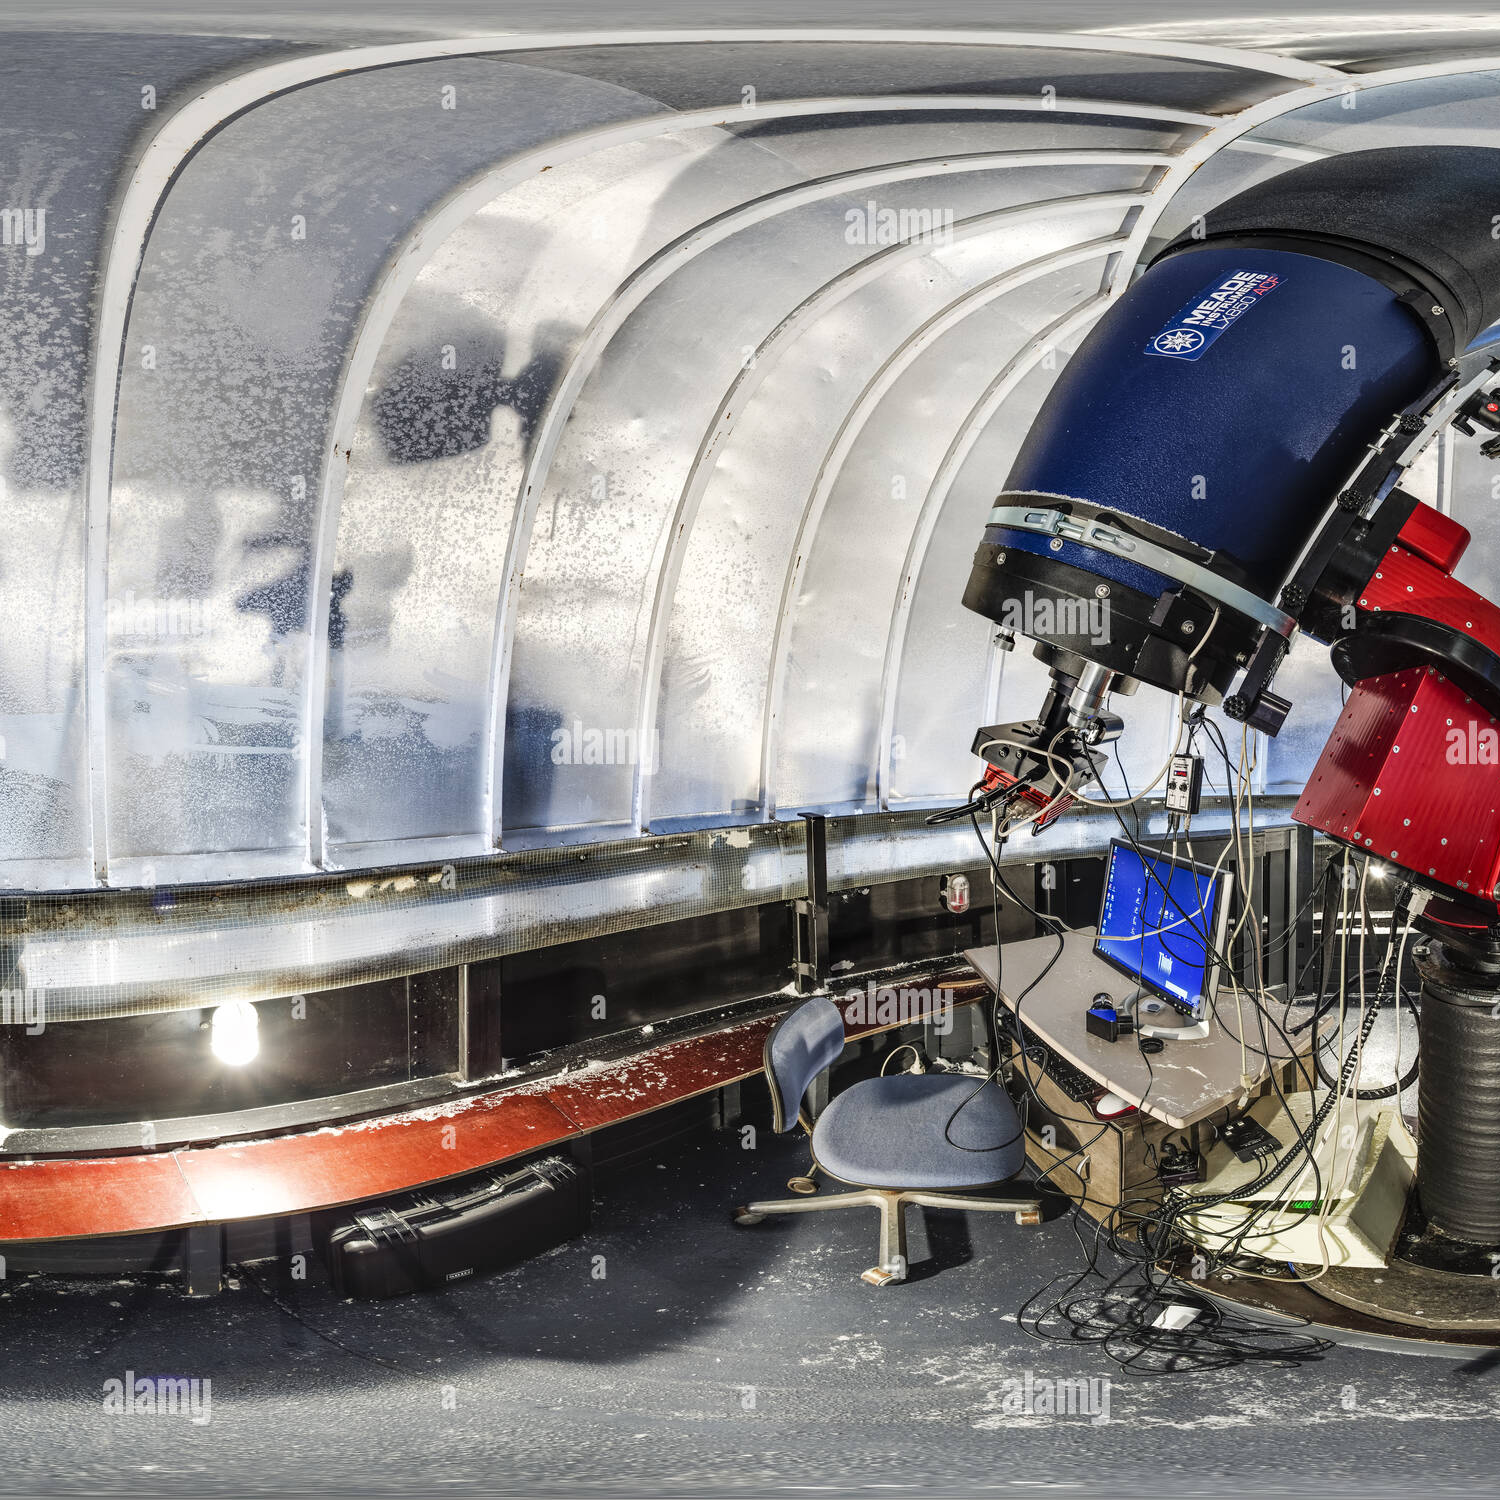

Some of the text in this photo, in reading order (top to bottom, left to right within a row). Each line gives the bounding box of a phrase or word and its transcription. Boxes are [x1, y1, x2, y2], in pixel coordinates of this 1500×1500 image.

[1182, 271, 1257, 325] MEADE
[1200, 274, 1269, 327] INSTRUMENTS
[1211, 276, 1279, 330] LX850 ACF
